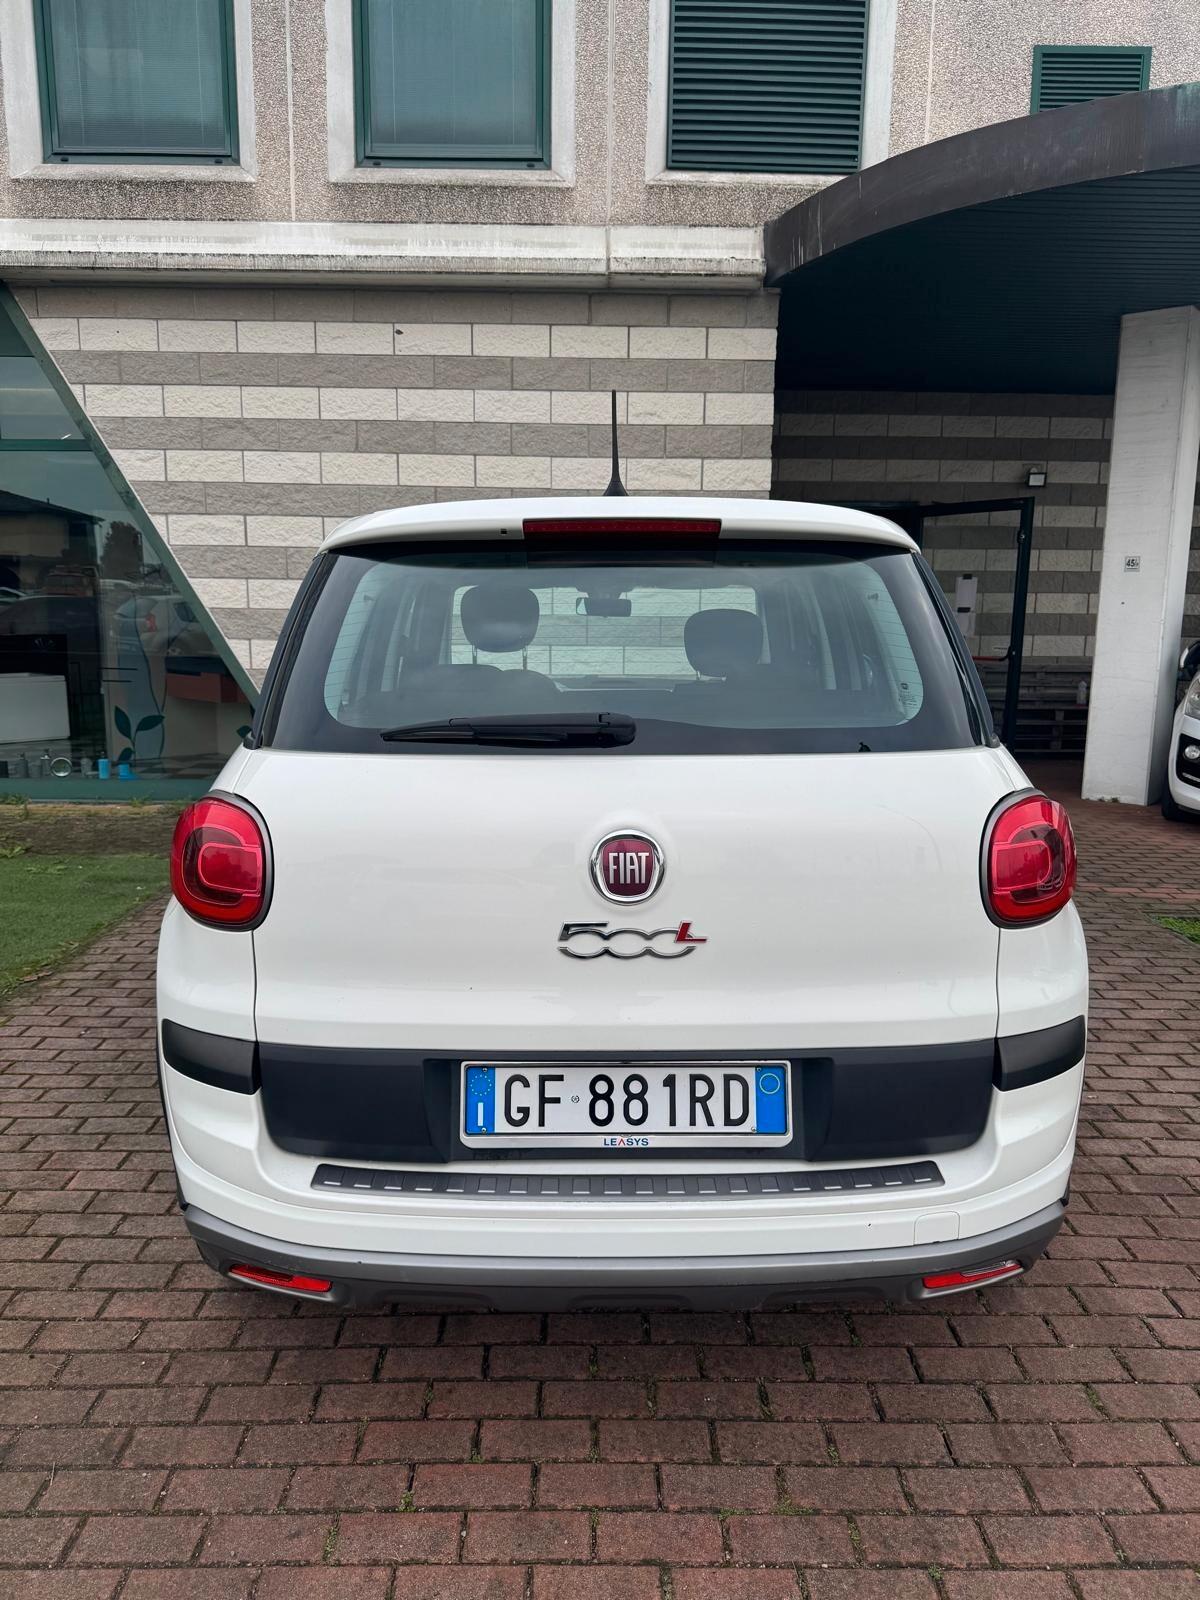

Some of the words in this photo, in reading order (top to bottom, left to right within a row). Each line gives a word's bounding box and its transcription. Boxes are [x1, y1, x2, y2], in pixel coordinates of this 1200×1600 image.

[608, 852, 650, 884] FIAT
[504, 1074, 565, 1128] GF
[589, 1073, 750, 1128] 881RD
[603, 1137, 650, 1147] LEASYS
